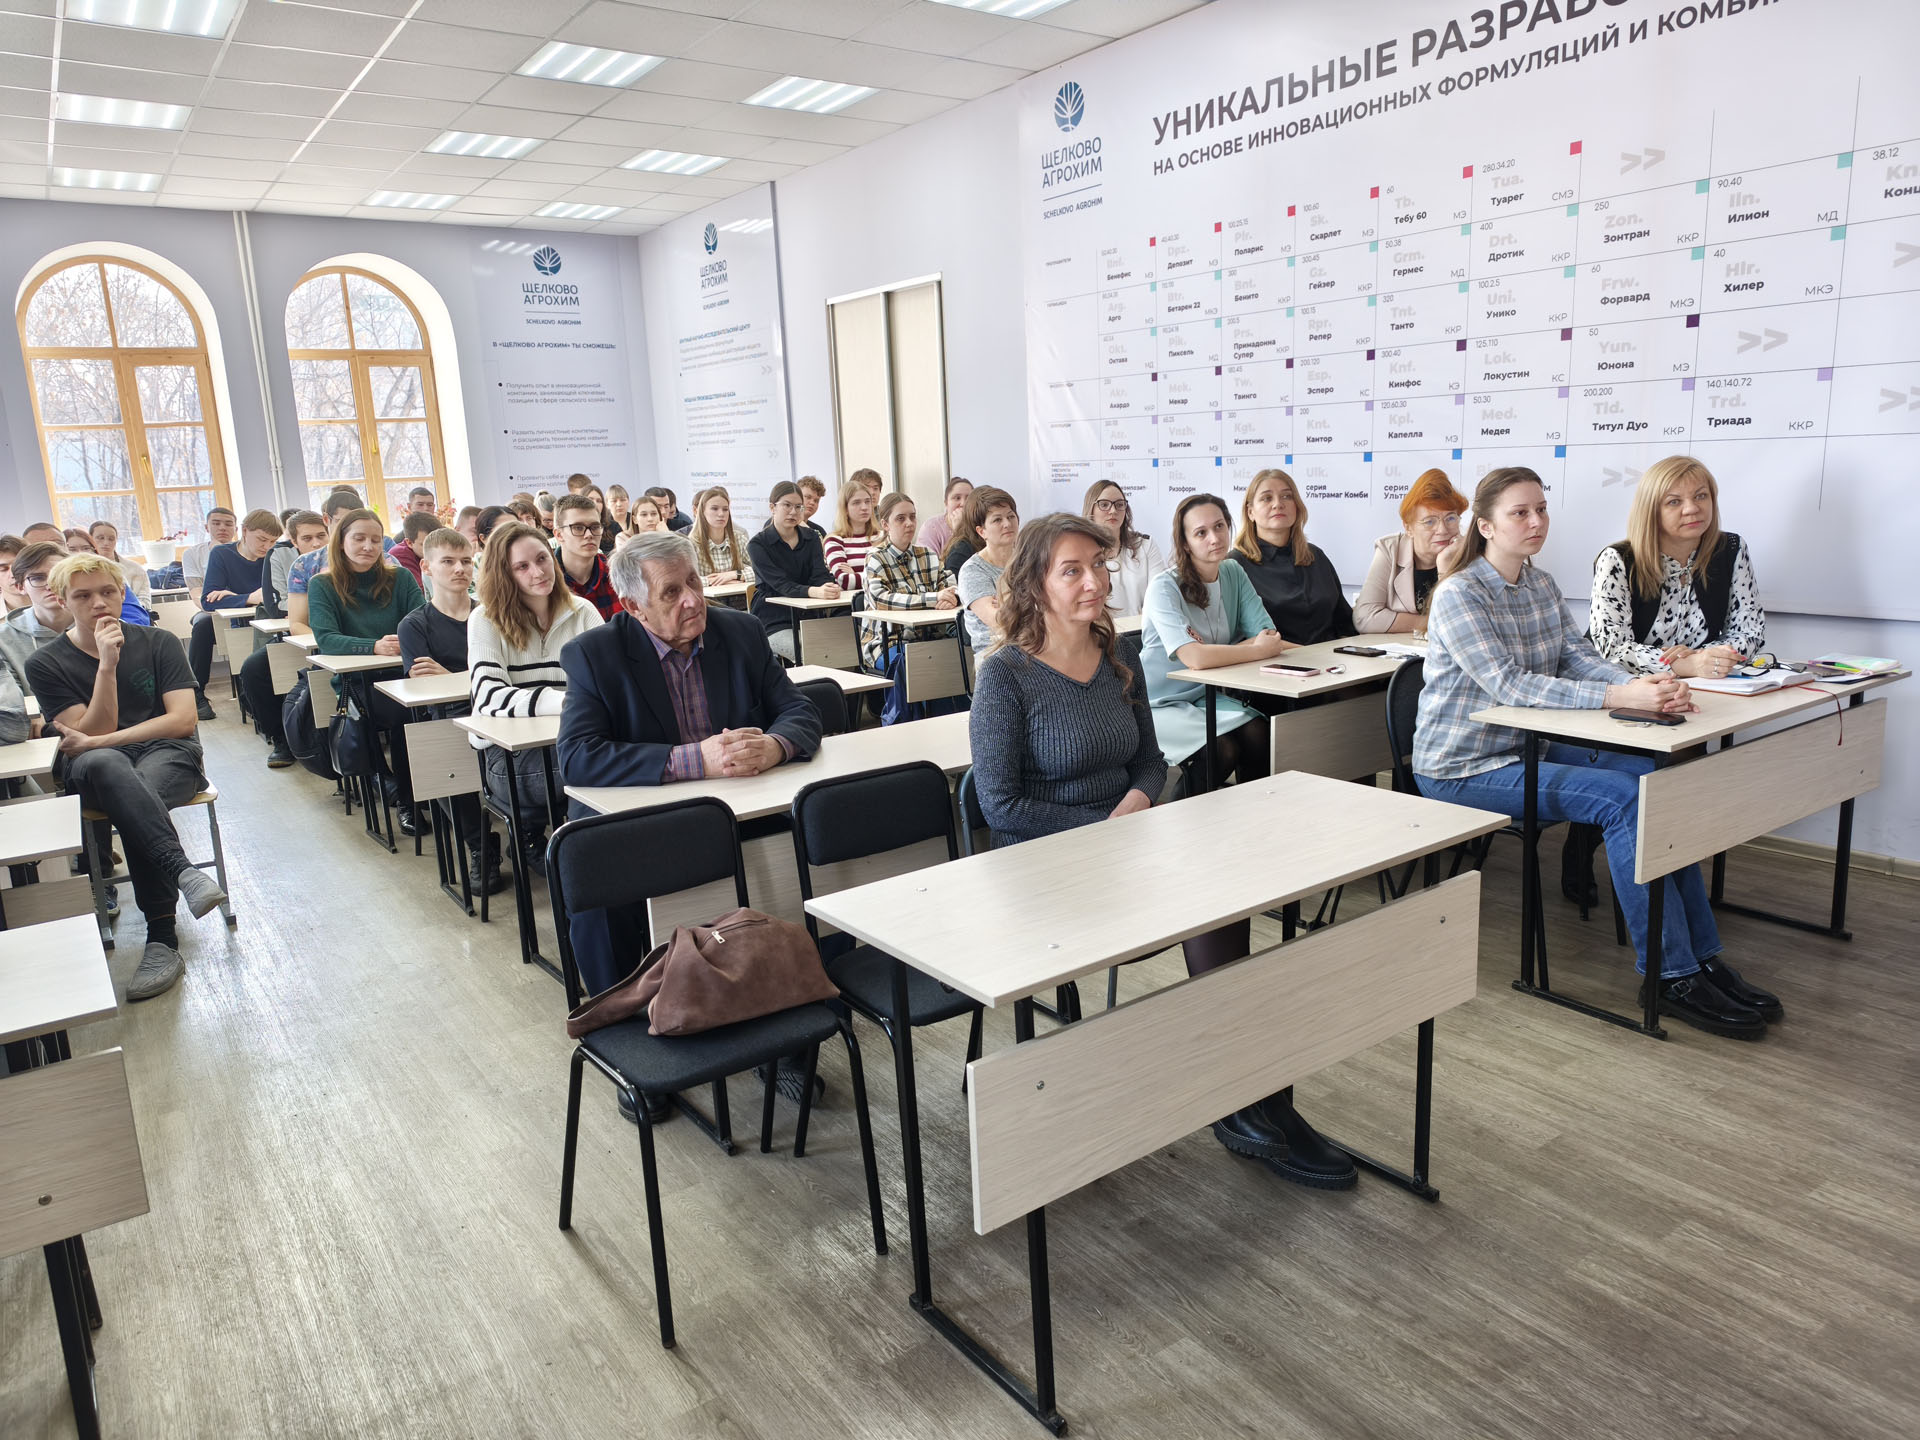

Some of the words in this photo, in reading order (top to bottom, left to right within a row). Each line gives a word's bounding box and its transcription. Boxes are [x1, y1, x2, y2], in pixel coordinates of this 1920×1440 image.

[1152, 38, 1398, 146] УНИКАЛЬНЫЕ
[1153, 157, 1174, 175] НА
[1178, 136, 1243, 168] ОСНОВЕ
[1248, 82, 1432, 150] ИННОВАЦИОННЫХ
[1437, 23, 1620, 97] ФОРМУЛЯЦИЙ
[1629, 18, 1648, 44] И
[1041, 136, 1102, 170] ЩЕЛКОВО
[1872, 147, 1899, 160] 38.12
[1482, 158, 1516, 173] 280.34.20
[1042, 156, 1103, 189] АГРОХИМ
[1491, 174, 1524, 189] Tua.
[1717, 176, 1742, 188] 90.40
[1386, 185, 1395, 194] 60
[1491, 192, 1525, 206] Туарег
[1552, 190, 1574, 201] СМЭ
[1303, 202, 1320, 212] 100.60
[1394, 195, 1415, 209] Tb.
[1594, 201, 1610, 211] 250
[1043, 204, 1074, 220] SCHELKOVO
[1075, 196, 1103, 211] AGROHIM
[1394, 213, 1416, 225] Тебу
[1416, 211, 1427, 221] 60
[1453, 210, 1467, 220] МЭ
[1727, 210, 1770, 223] Илион
[1817, 210, 1839, 223] МД
[1310, 214, 1329, 227] Sk.
[1604, 213, 1643, 229] Zon.
[1480, 222, 1493, 231] 400
[1310, 229, 1342, 241] Скарлет
[1361, 228, 1375, 238] МЭ
[1603, 229, 1650, 243] Зонтран
[1677, 232, 1699, 244] ККР
[1385, 239, 1402, 249] 50.38
[1489, 233, 1518, 248] Drt.
[1234, 245, 1264, 256] Поларис
[1281, 244, 1292, 253] МЭ
[1713, 248, 1726, 258] 40
[1392, 250, 1425, 264] Grm.
[1488, 249, 1525, 263] Дротик
[1551, 251, 1571, 262] ККР
[699, 259, 728, 278] ЩЕЛКОВО
[1167, 259, 1194, 270] Депозит
[1591, 264, 1601, 273] 60
[1107, 271, 1131, 281] Бенефис
[1392, 265, 1424, 277] Гермес
[1450, 268, 1465, 278] МД
[701, 272, 729, 289] АГРОХИМ
[1308, 280, 1336, 290] Гейзер
[1478, 279, 1500, 289] 100.2.5
[1602, 278, 1640, 291] Frw.
[521, 283, 578, 294] ЩЕЛКОВО
[1357, 283, 1373, 292] ККР
[1723, 281, 1765, 293] Хилер
[1804, 284, 1834, 296] МКЭ
[523, 295, 580, 306] АГРОХИМ
[1234, 292, 1259, 302] Бенито
[1383, 295, 1394, 303] 320
[1487, 290, 1516, 305] Uni.
[1600, 292, 1651, 306] Форвард
[1167, 304, 1192, 313] Бетарен
[1193, 301, 1201, 310] 22
[1670, 298, 1695, 309] МКЭ
[1301, 306, 1316, 316] 100.15
[1390, 305, 1416, 319] Tnt.
[1486, 309, 1517, 319] Унико
[1108, 314, 1122, 322] Арго
[1548, 313, 1568, 323] ККР
[1390, 322, 1415, 331] Танто
[1445, 325, 1462, 335] ККР
[1588, 327, 1599, 336] 50
[1309, 333, 1332, 342] Репер
[1355, 336, 1371, 345] ККР
[1233, 339, 1276, 350] Примадонна
[1476, 338, 1499, 349] 125.110
[1599, 340, 1638, 354] Yun.
[1168, 349, 1194, 358] Пиксель
[1233, 351, 1254, 360] Супер
[1381, 349, 1401, 358] 300.40
[1484, 352, 1517, 365] Lok.
[1389, 360, 1416, 374] Knf.
[1597, 360, 1635, 371] Юнона
[1672, 362, 1690, 372] МЭ
[1483, 369, 1530, 381] Локустин
[1552, 373, 1565, 382] КС
[1389, 379, 1422, 389] Кинфос
[1449, 382, 1460, 391] КЭ
[1706, 377, 1752, 389] 140.140.72
[1307, 386, 1334, 395] Эсперо
[1359, 389, 1370, 397] КС
[1583, 386, 1613, 397] 200.200
[1169, 397, 1188, 406] Мекар
[1234, 392, 1257, 401] Твинго
[1473, 395, 1491, 404] 50.30
[1708, 394, 1746, 408] Trd.
[1381, 400, 1407, 409] 120.60.30
[1299, 407, 1310, 415] 200
[1481, 407, 1518, 420] Med.
[1592, 421, 1624, 432] Титул
[1626, 420, 1648, 432] Дуо
[1707, 416, 1752, 428] Триада
[1788, 421, 1814, 431] ККР
[1388, 430, 1423, 439] Капелла
[1480, 427, 1510, 436] Медея
[1546, 432, 1561, 440] МЭ
[1663, 426, 1685, 436] ККР
[1234, 437, 1265, 445] Кагатник
[1306, 436, 1333, 444] Кантор
[1445, 434, 1459, 443] МЭ
[1275, 442, 1289, 450] ВРК
[1353, 440, 1369, 448] ККР
[1384, 484, 1409, 492] серия
[1305, 491, 1343, 500] Ультрамаг
